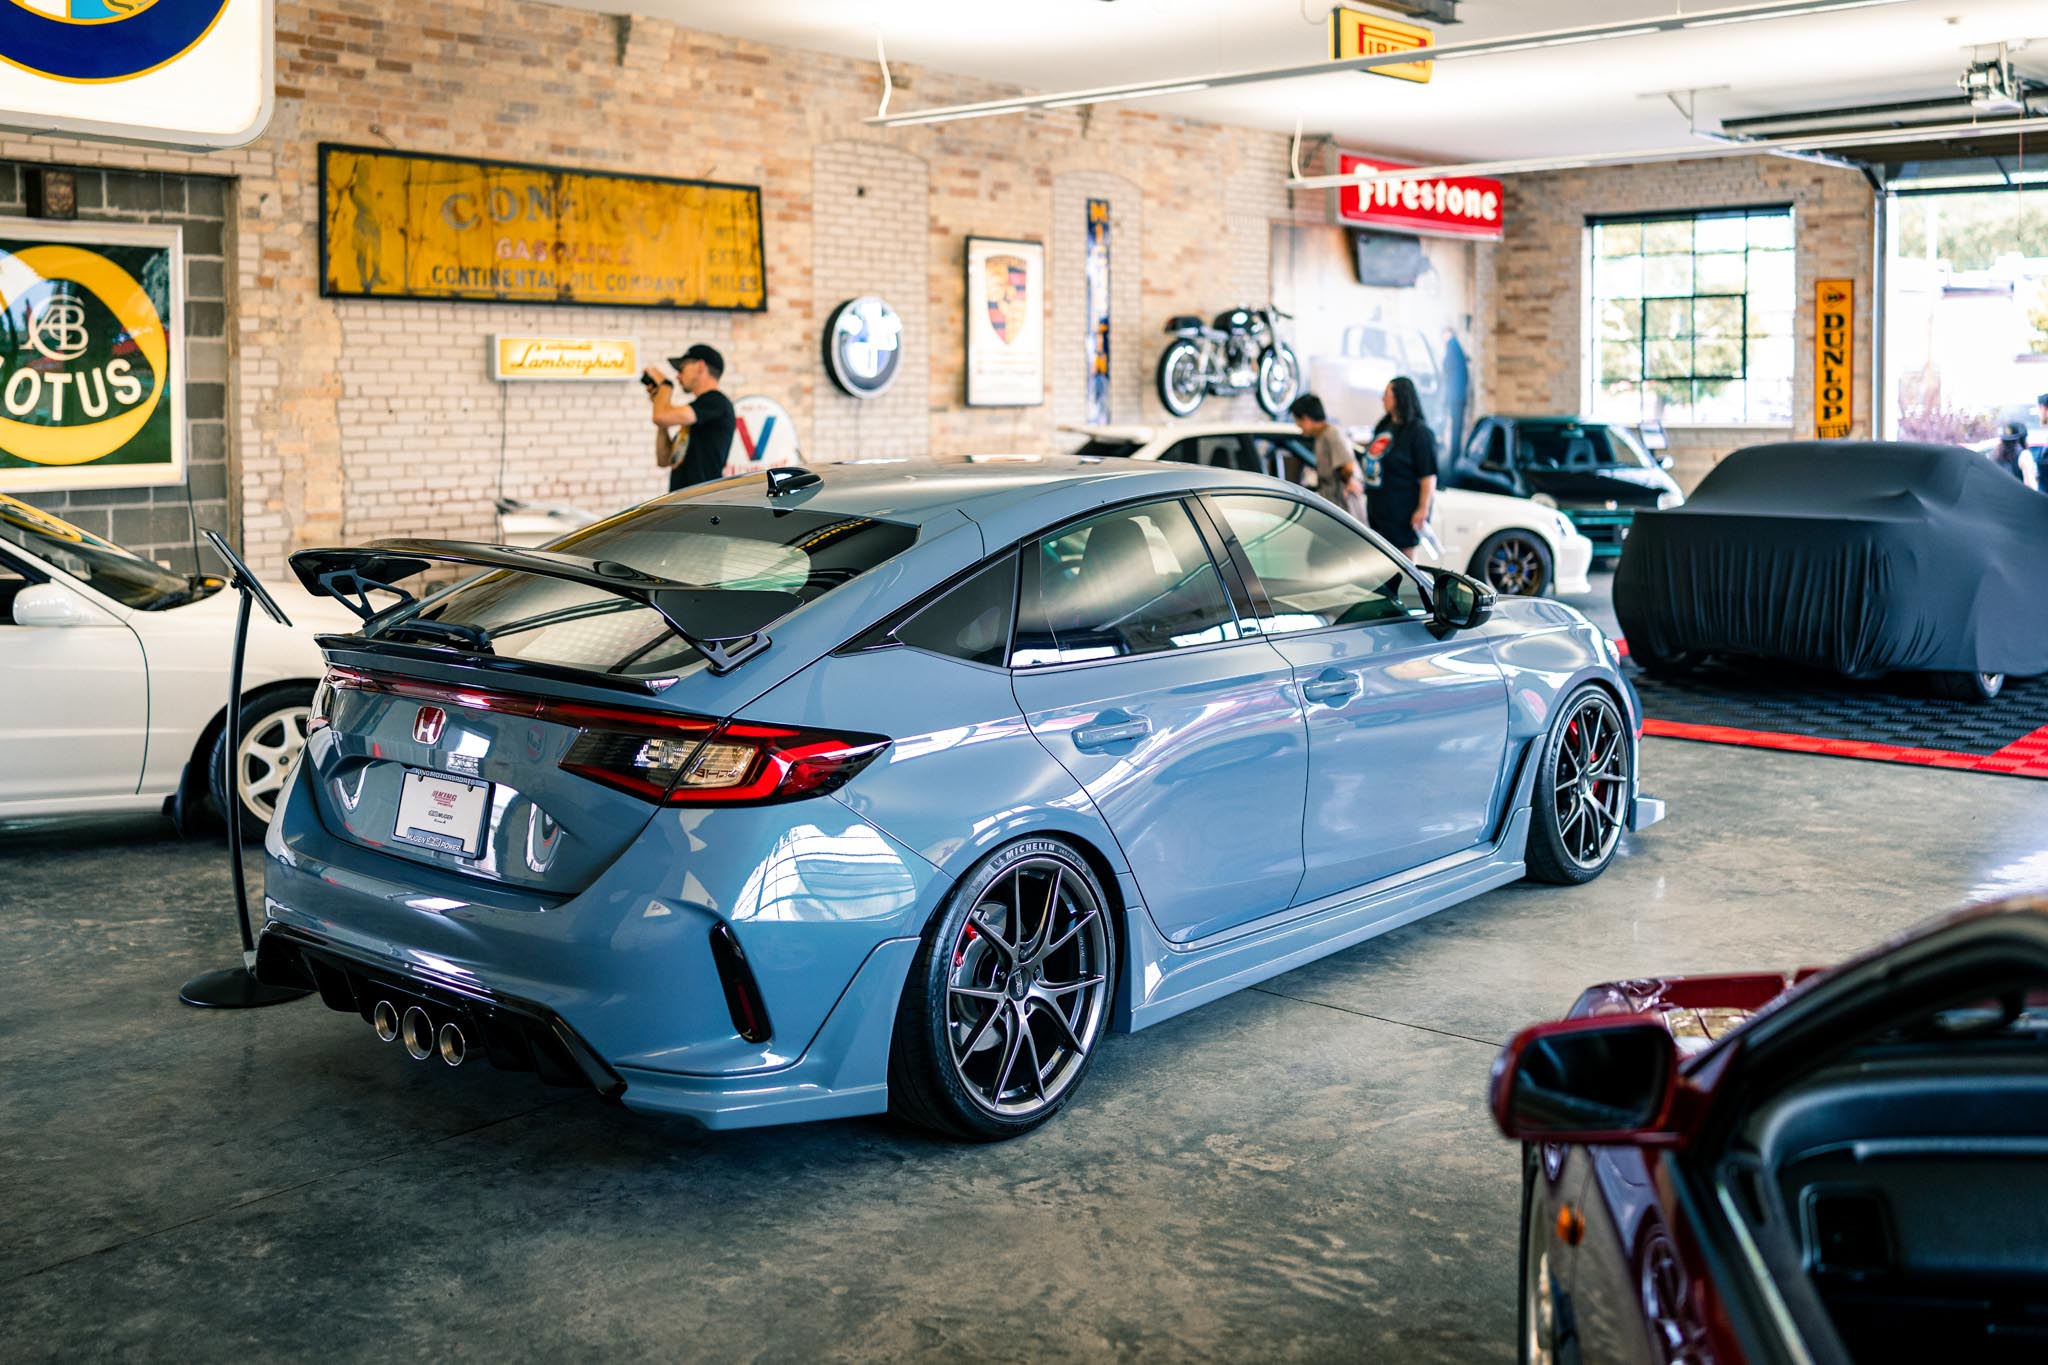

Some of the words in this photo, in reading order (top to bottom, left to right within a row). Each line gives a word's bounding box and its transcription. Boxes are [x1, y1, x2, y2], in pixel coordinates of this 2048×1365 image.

[1354, 163, 1498, 221] Firestone
[432, 265, 557, 288] CONTINENTAL
[570, 273, 597, 291] OIL
[605, 273, 687, 294] COMPANY
[510, 342, 628, 375] Lamborghini
[1823, 313, 1845, 421] DUNLOP
[0, 355, 142, 422] OTUS
[1005, 842, 1055, 860] MICHELIN
